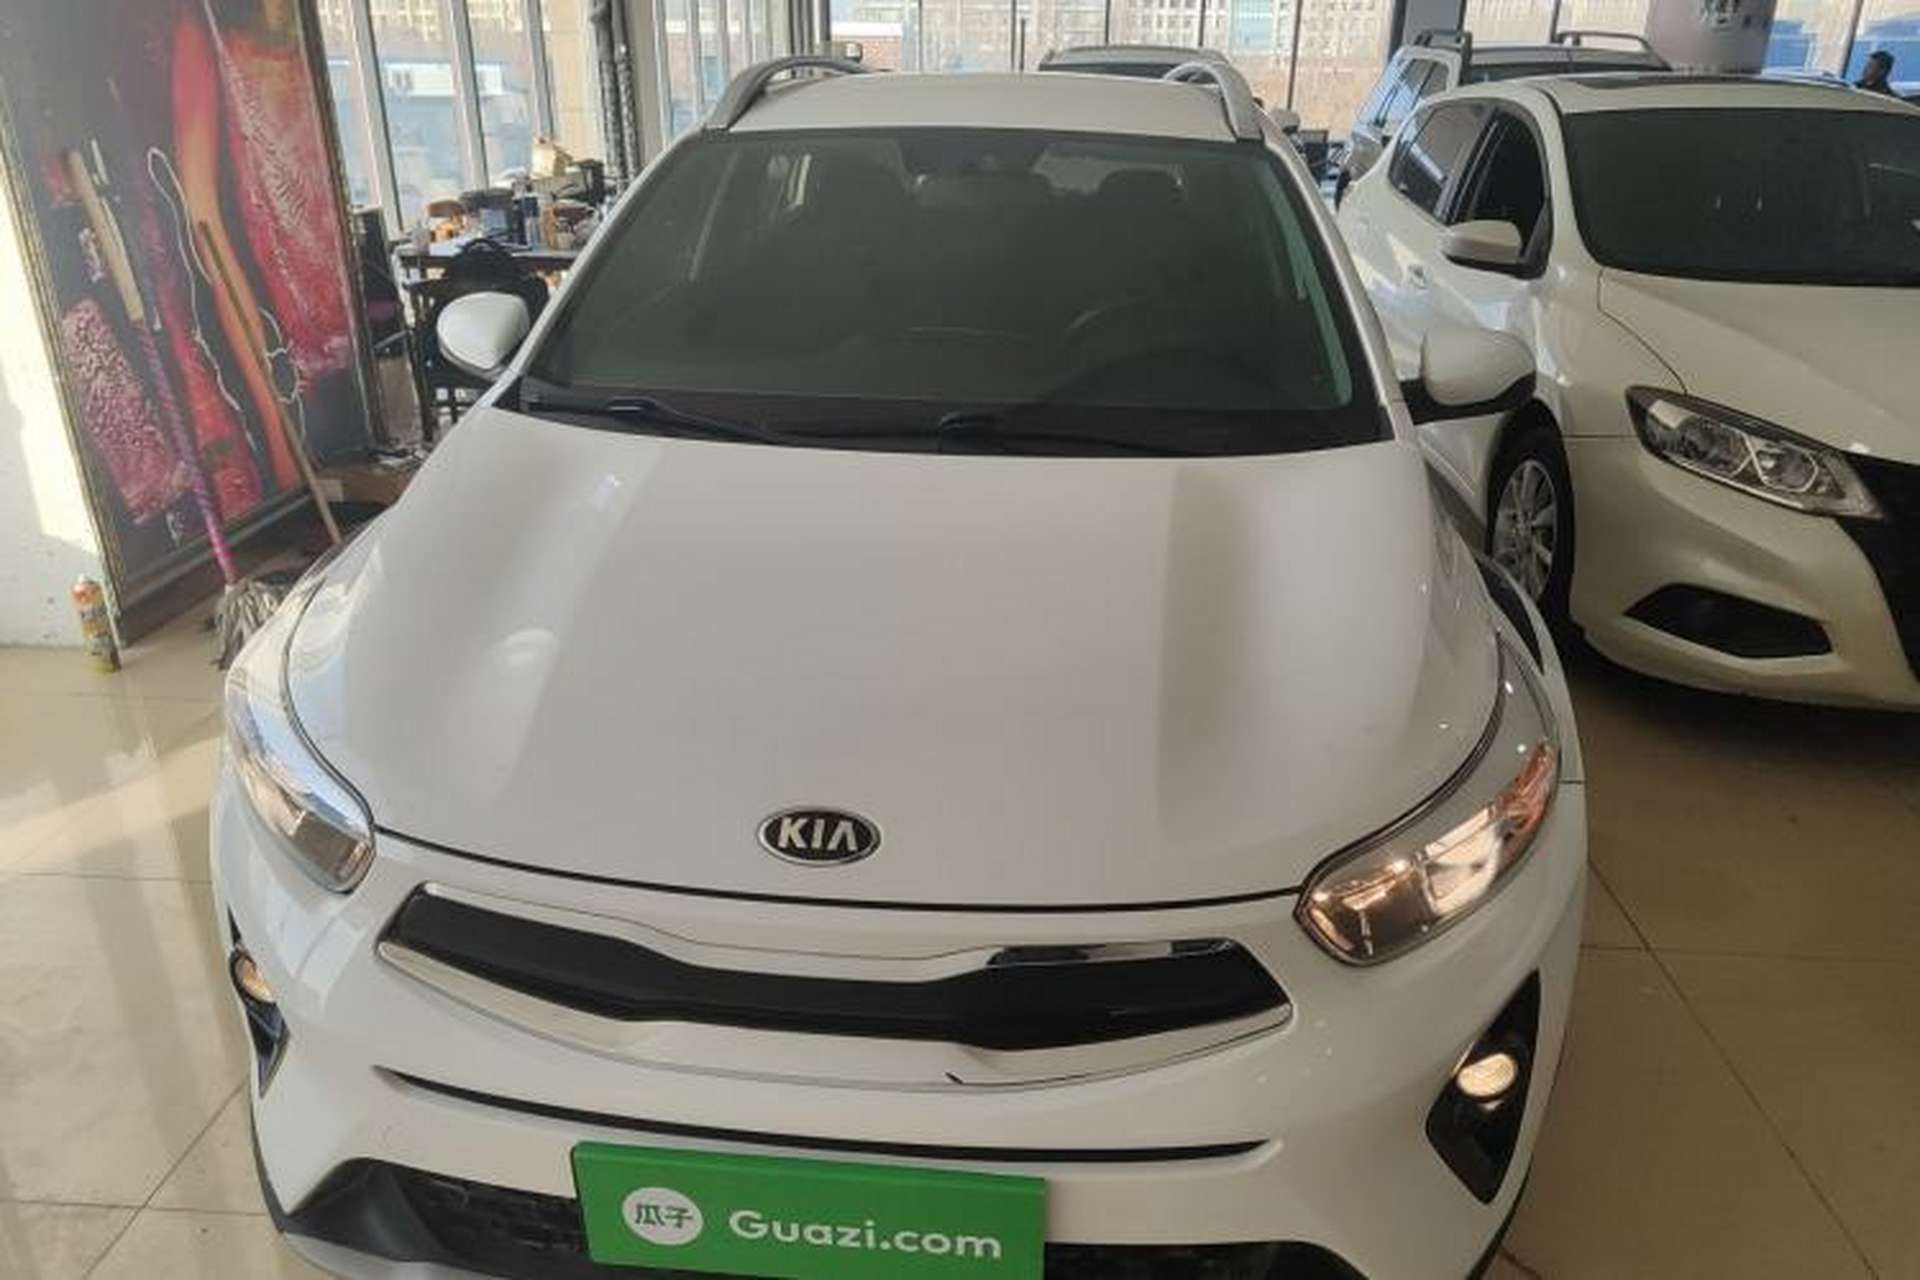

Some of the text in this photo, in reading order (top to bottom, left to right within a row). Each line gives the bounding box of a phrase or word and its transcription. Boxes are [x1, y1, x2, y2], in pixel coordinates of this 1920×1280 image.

[778, 818, 858, 851] KIA
[634, 1202, 694, 1229] 瓜子
[729, 1209, 1002, 1259] Guazi.com
